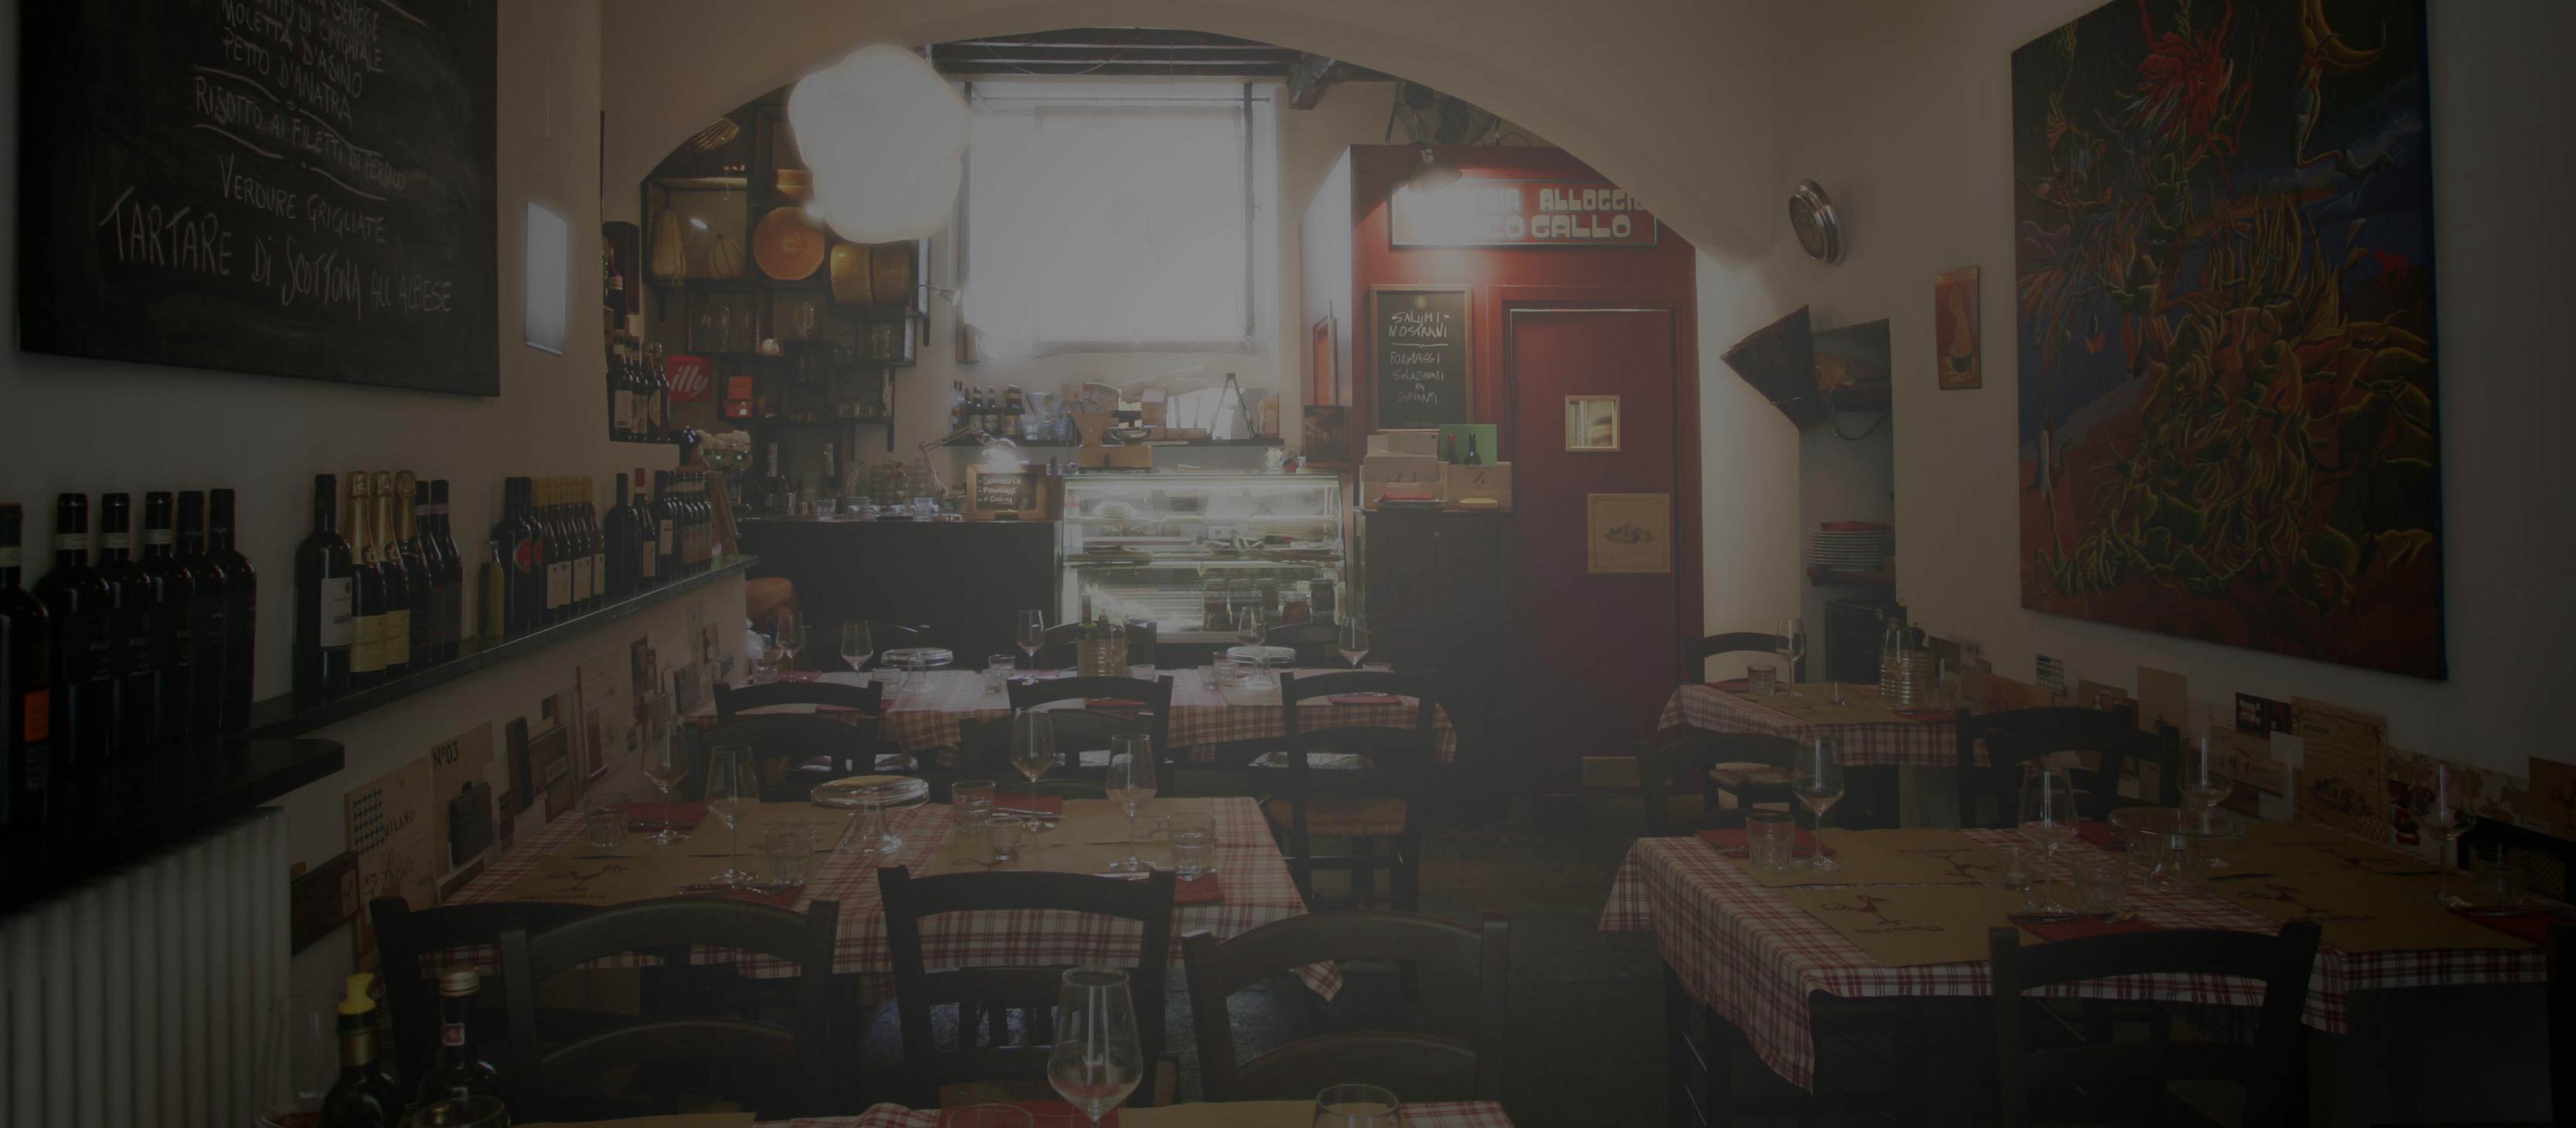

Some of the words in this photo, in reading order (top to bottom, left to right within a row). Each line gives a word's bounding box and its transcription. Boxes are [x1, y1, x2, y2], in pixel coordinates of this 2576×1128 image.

[217, 152, 296, 220] VERDURE
[307, 193, 384, 243] GRIGLIATE
[1540, 188, 1645, 211] ALLOGGI
[1531, 215, 1631, 239] GALLO
[99, 185, 233, 276] TARTARE
[281, 234, 362, 322] SCOTTONA
[1390, 351, 1440, 366] FORMAGGI
[670, 365, 710, 397] illy
